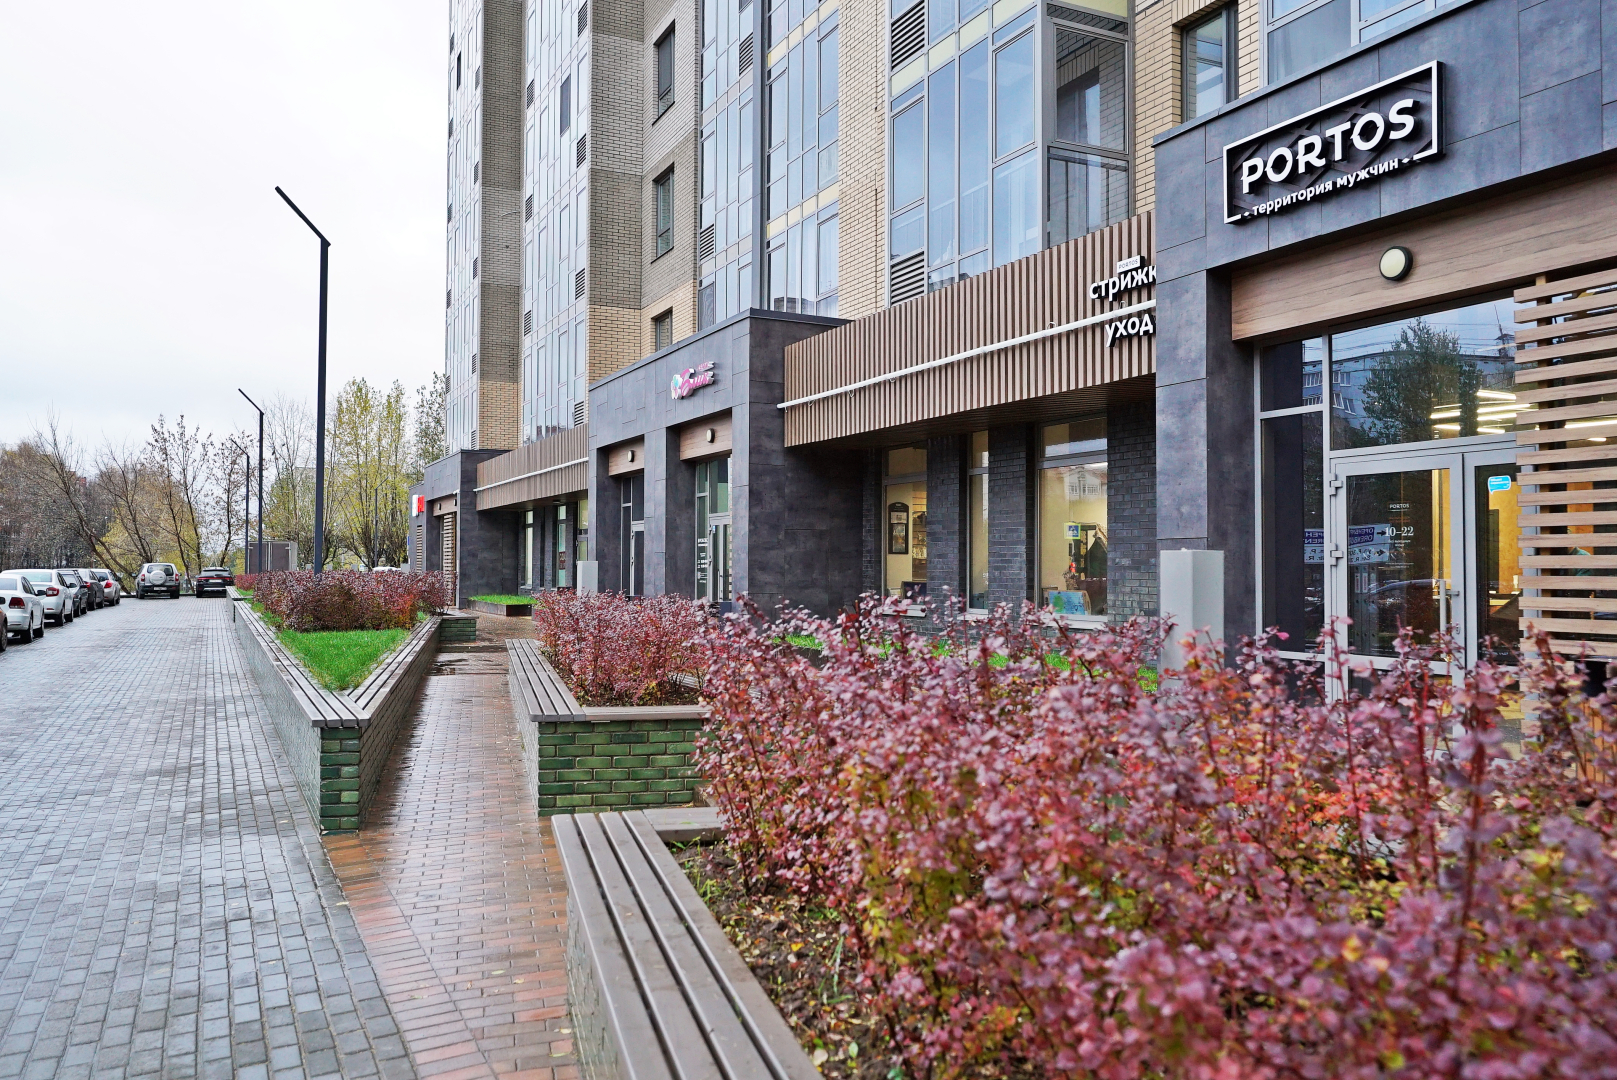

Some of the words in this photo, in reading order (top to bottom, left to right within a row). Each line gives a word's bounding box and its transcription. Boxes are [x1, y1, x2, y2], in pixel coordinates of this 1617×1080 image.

[1240, 98, 1416, 194] PORTOS
[1252, 181, 1333, 216] территория
[1337, 158, 1399, 188] мужчин
[1089, 264, 1156, 302] стрижк
[1104, 313, 1154, 348] уход
